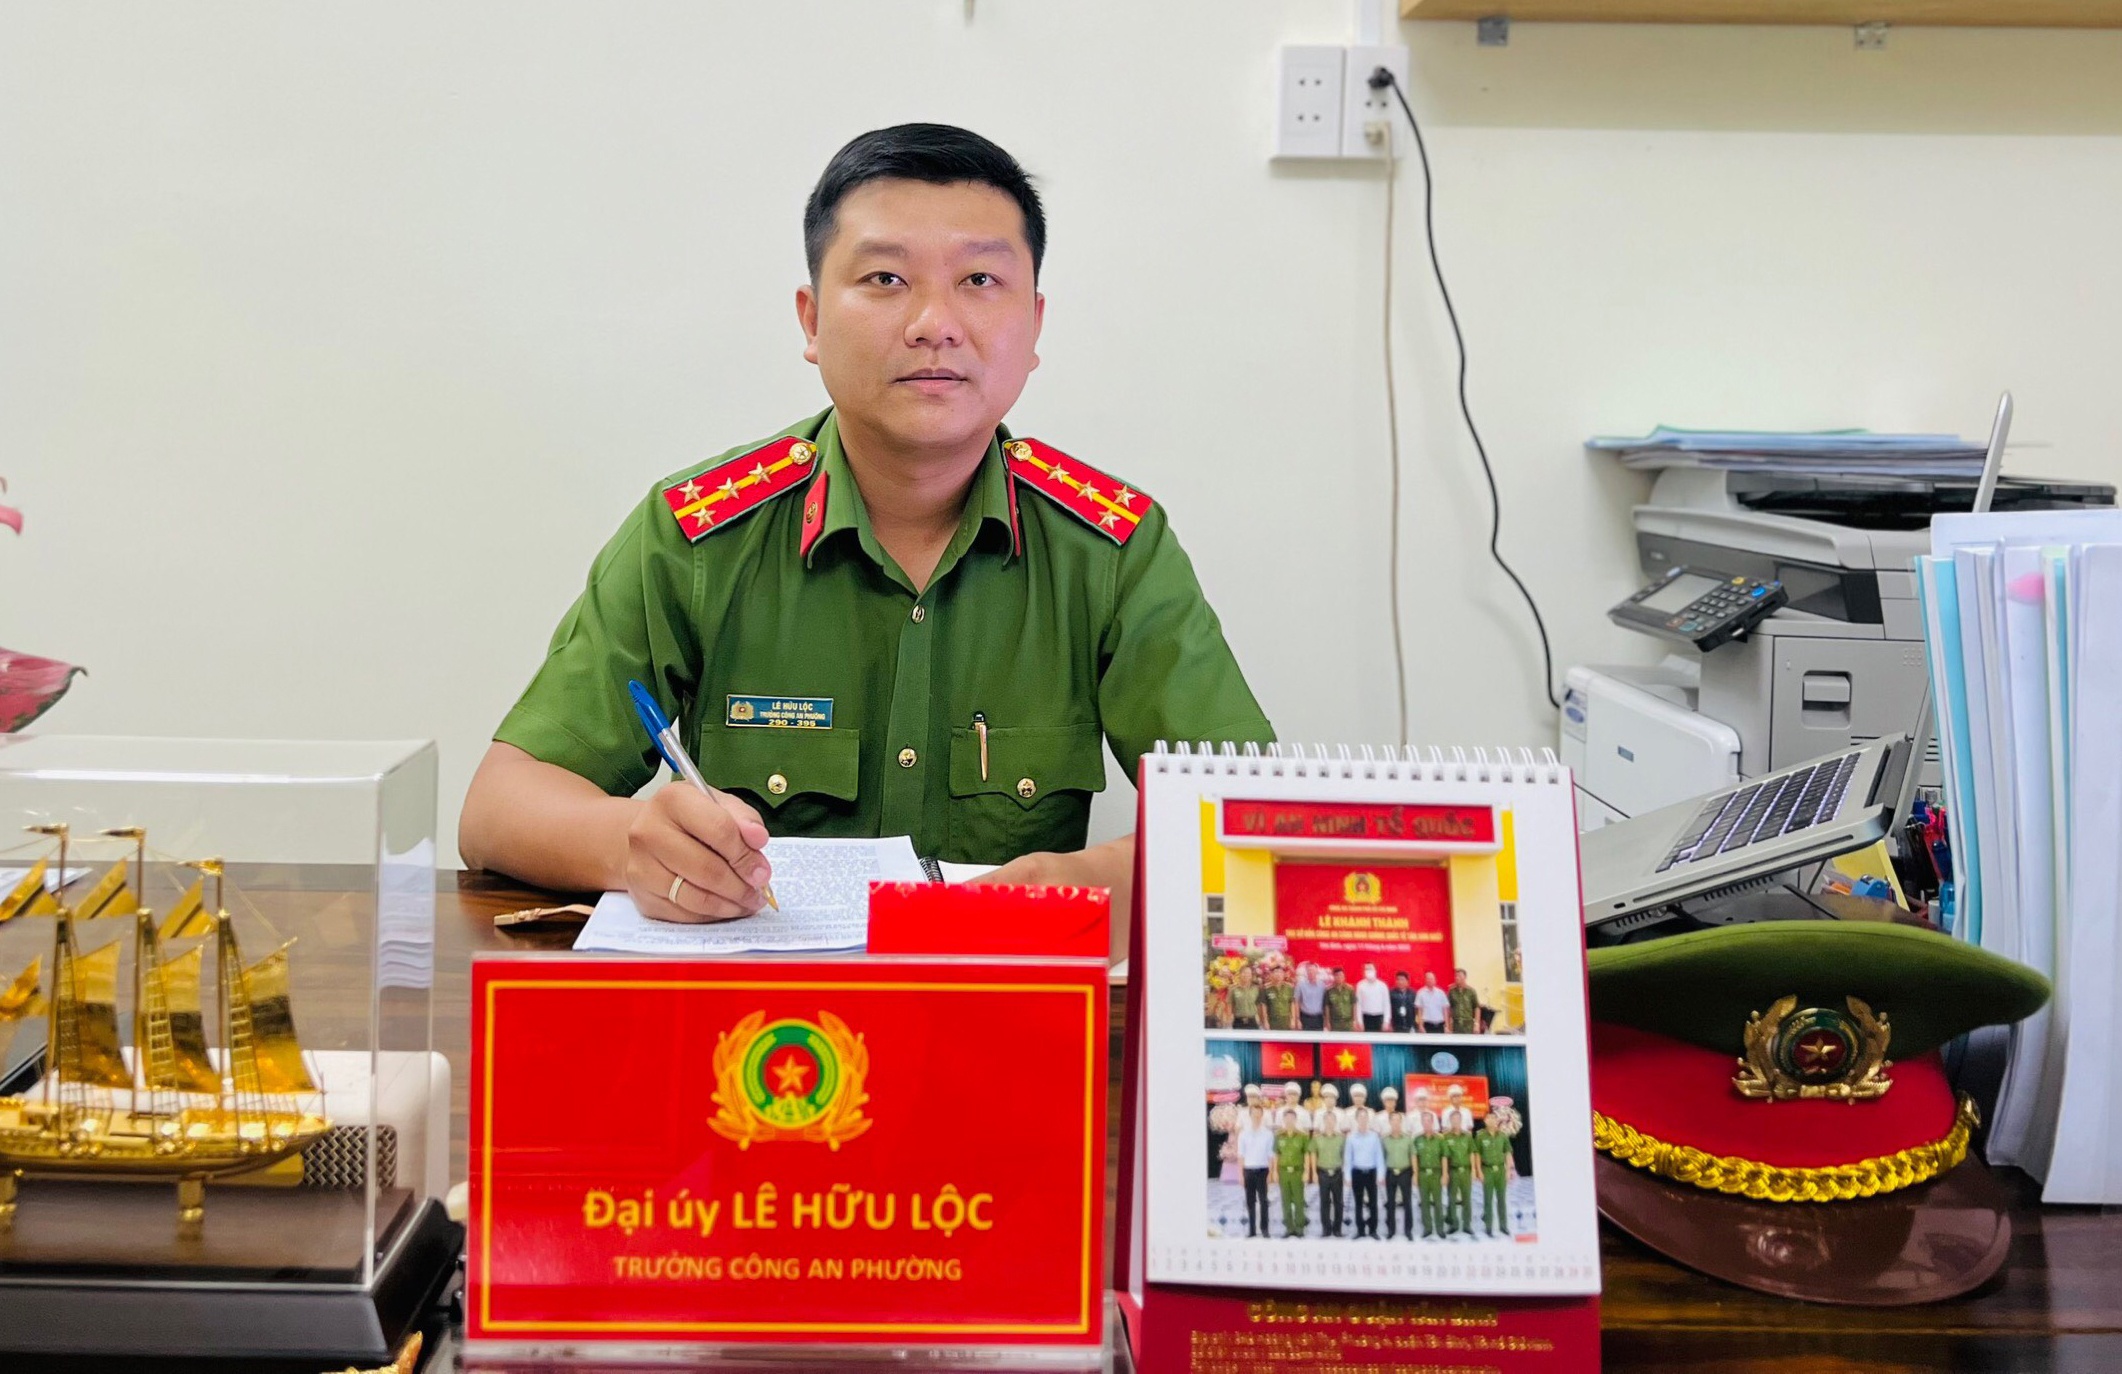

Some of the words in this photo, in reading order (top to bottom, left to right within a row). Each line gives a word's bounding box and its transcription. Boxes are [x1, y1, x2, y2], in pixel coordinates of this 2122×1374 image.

[583, 1190, 655, 1236] Đại
[668, 1190, 721, 1237] úy
[733, 1182, 778, 1230] LÊ
[793, 1183, 896, 1230] HỮU
[912, 1183, 994, 1238] LỘC
[614, 1251, 722, 1281] TRƯỞNG
[729, 1252, 800, 1281] CÔNG
[808, 1259, 844, 1280] AN
[851, 1255, 963, 1282] PHƯỜNG
